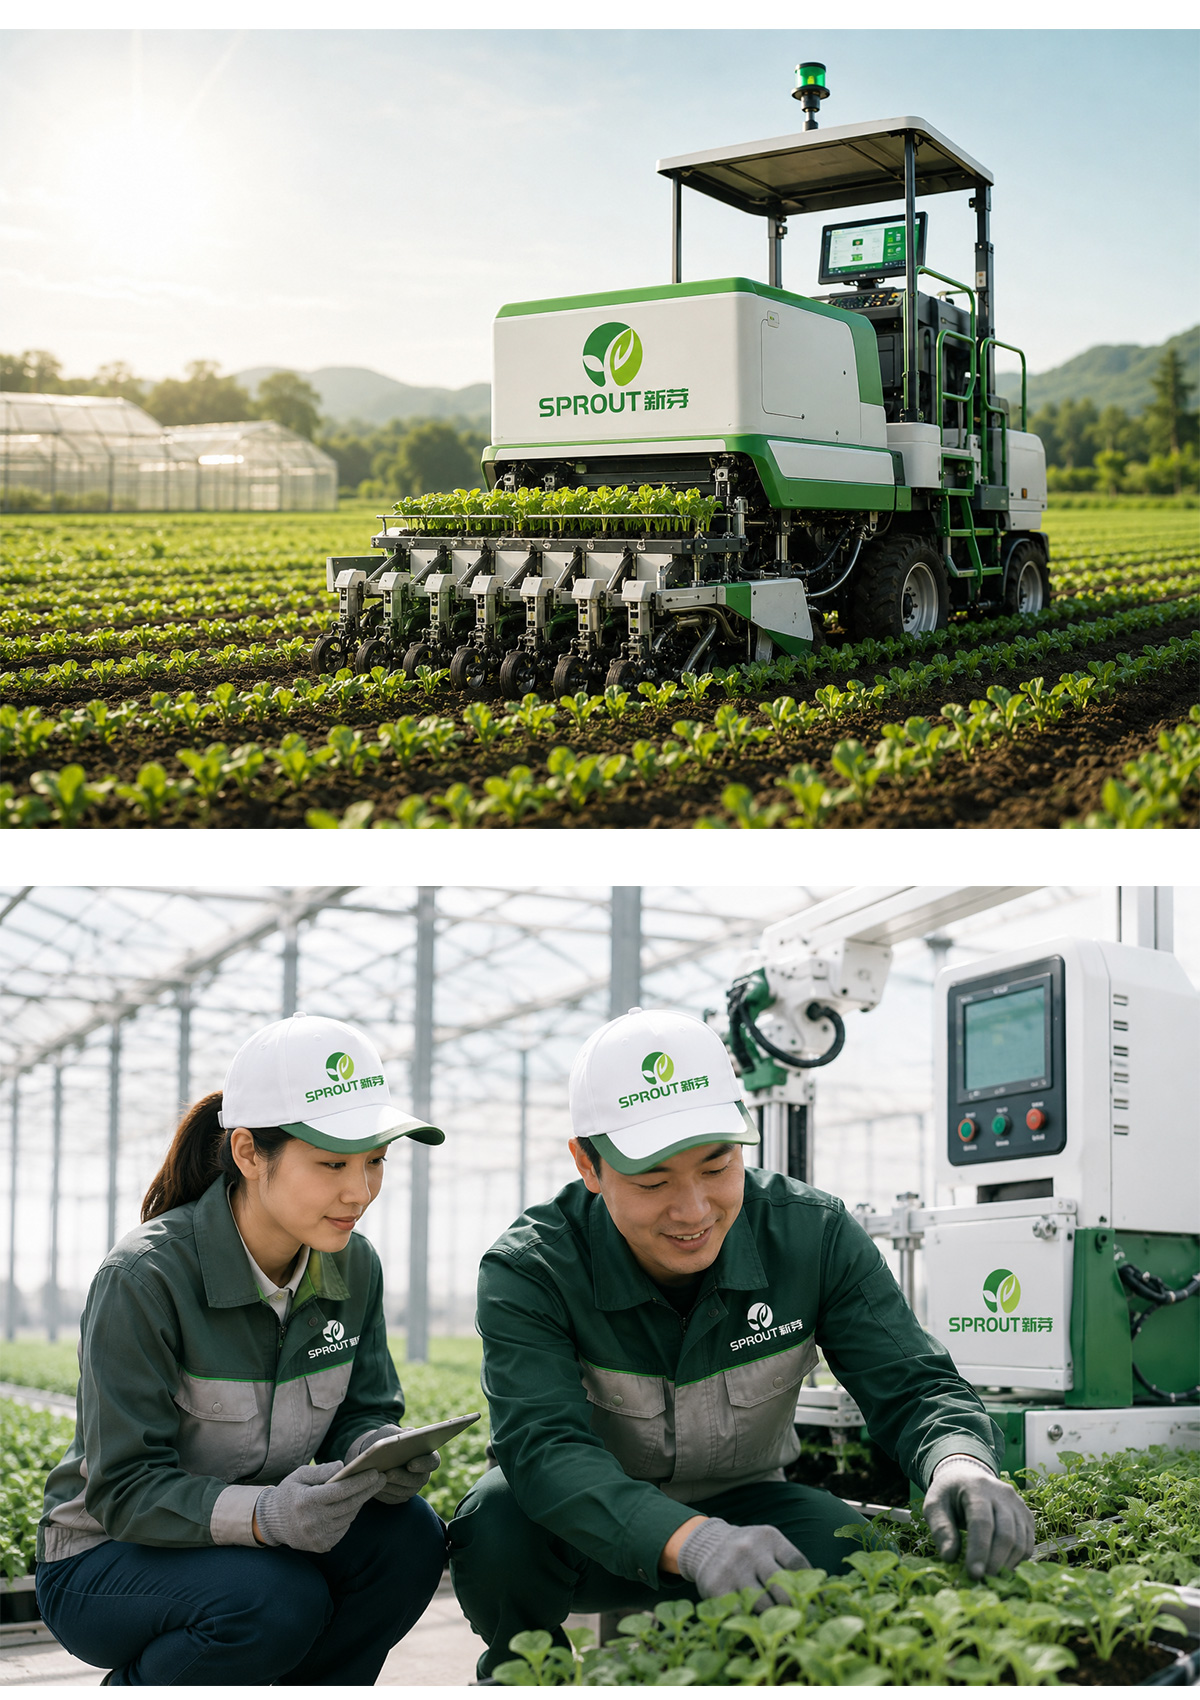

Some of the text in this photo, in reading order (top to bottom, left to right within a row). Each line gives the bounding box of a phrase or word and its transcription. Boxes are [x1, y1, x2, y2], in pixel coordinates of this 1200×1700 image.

[538, 388, 690, 418] SPROUT 新芽
[305, 1079, 359, 1103] SPROUT
[618, 1081, 679, 1109] SPROUT
[948, 1316, 1054, 1333] SPROUT 新芽
[729, 1327, 778, 1352] SPROUT
